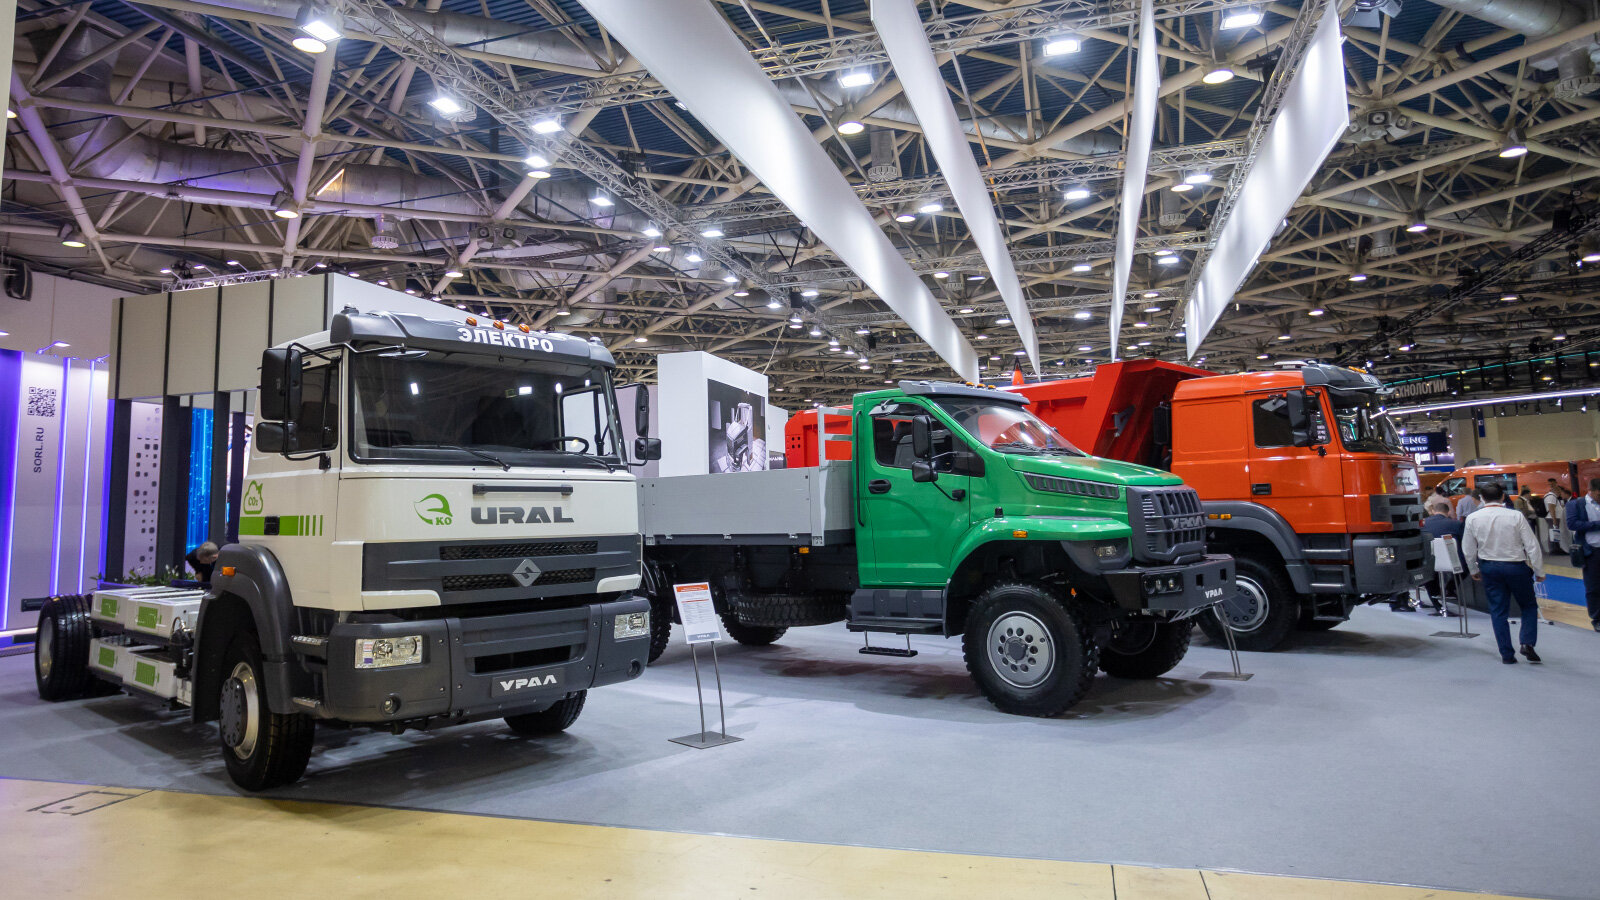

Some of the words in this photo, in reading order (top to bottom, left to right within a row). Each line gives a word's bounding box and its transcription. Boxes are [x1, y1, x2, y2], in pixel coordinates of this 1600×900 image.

[457, 327, 554, 353] ЭЛЕКТРО
[1399, 436, 1428, 445] ENG
[33, 427, 44, 473] SORL.RU
[471, 506, 574, 525] URAL
[1205, 588, 1223, 599] УРАЛ
[500, 674, 557, 691] УРАЛ
